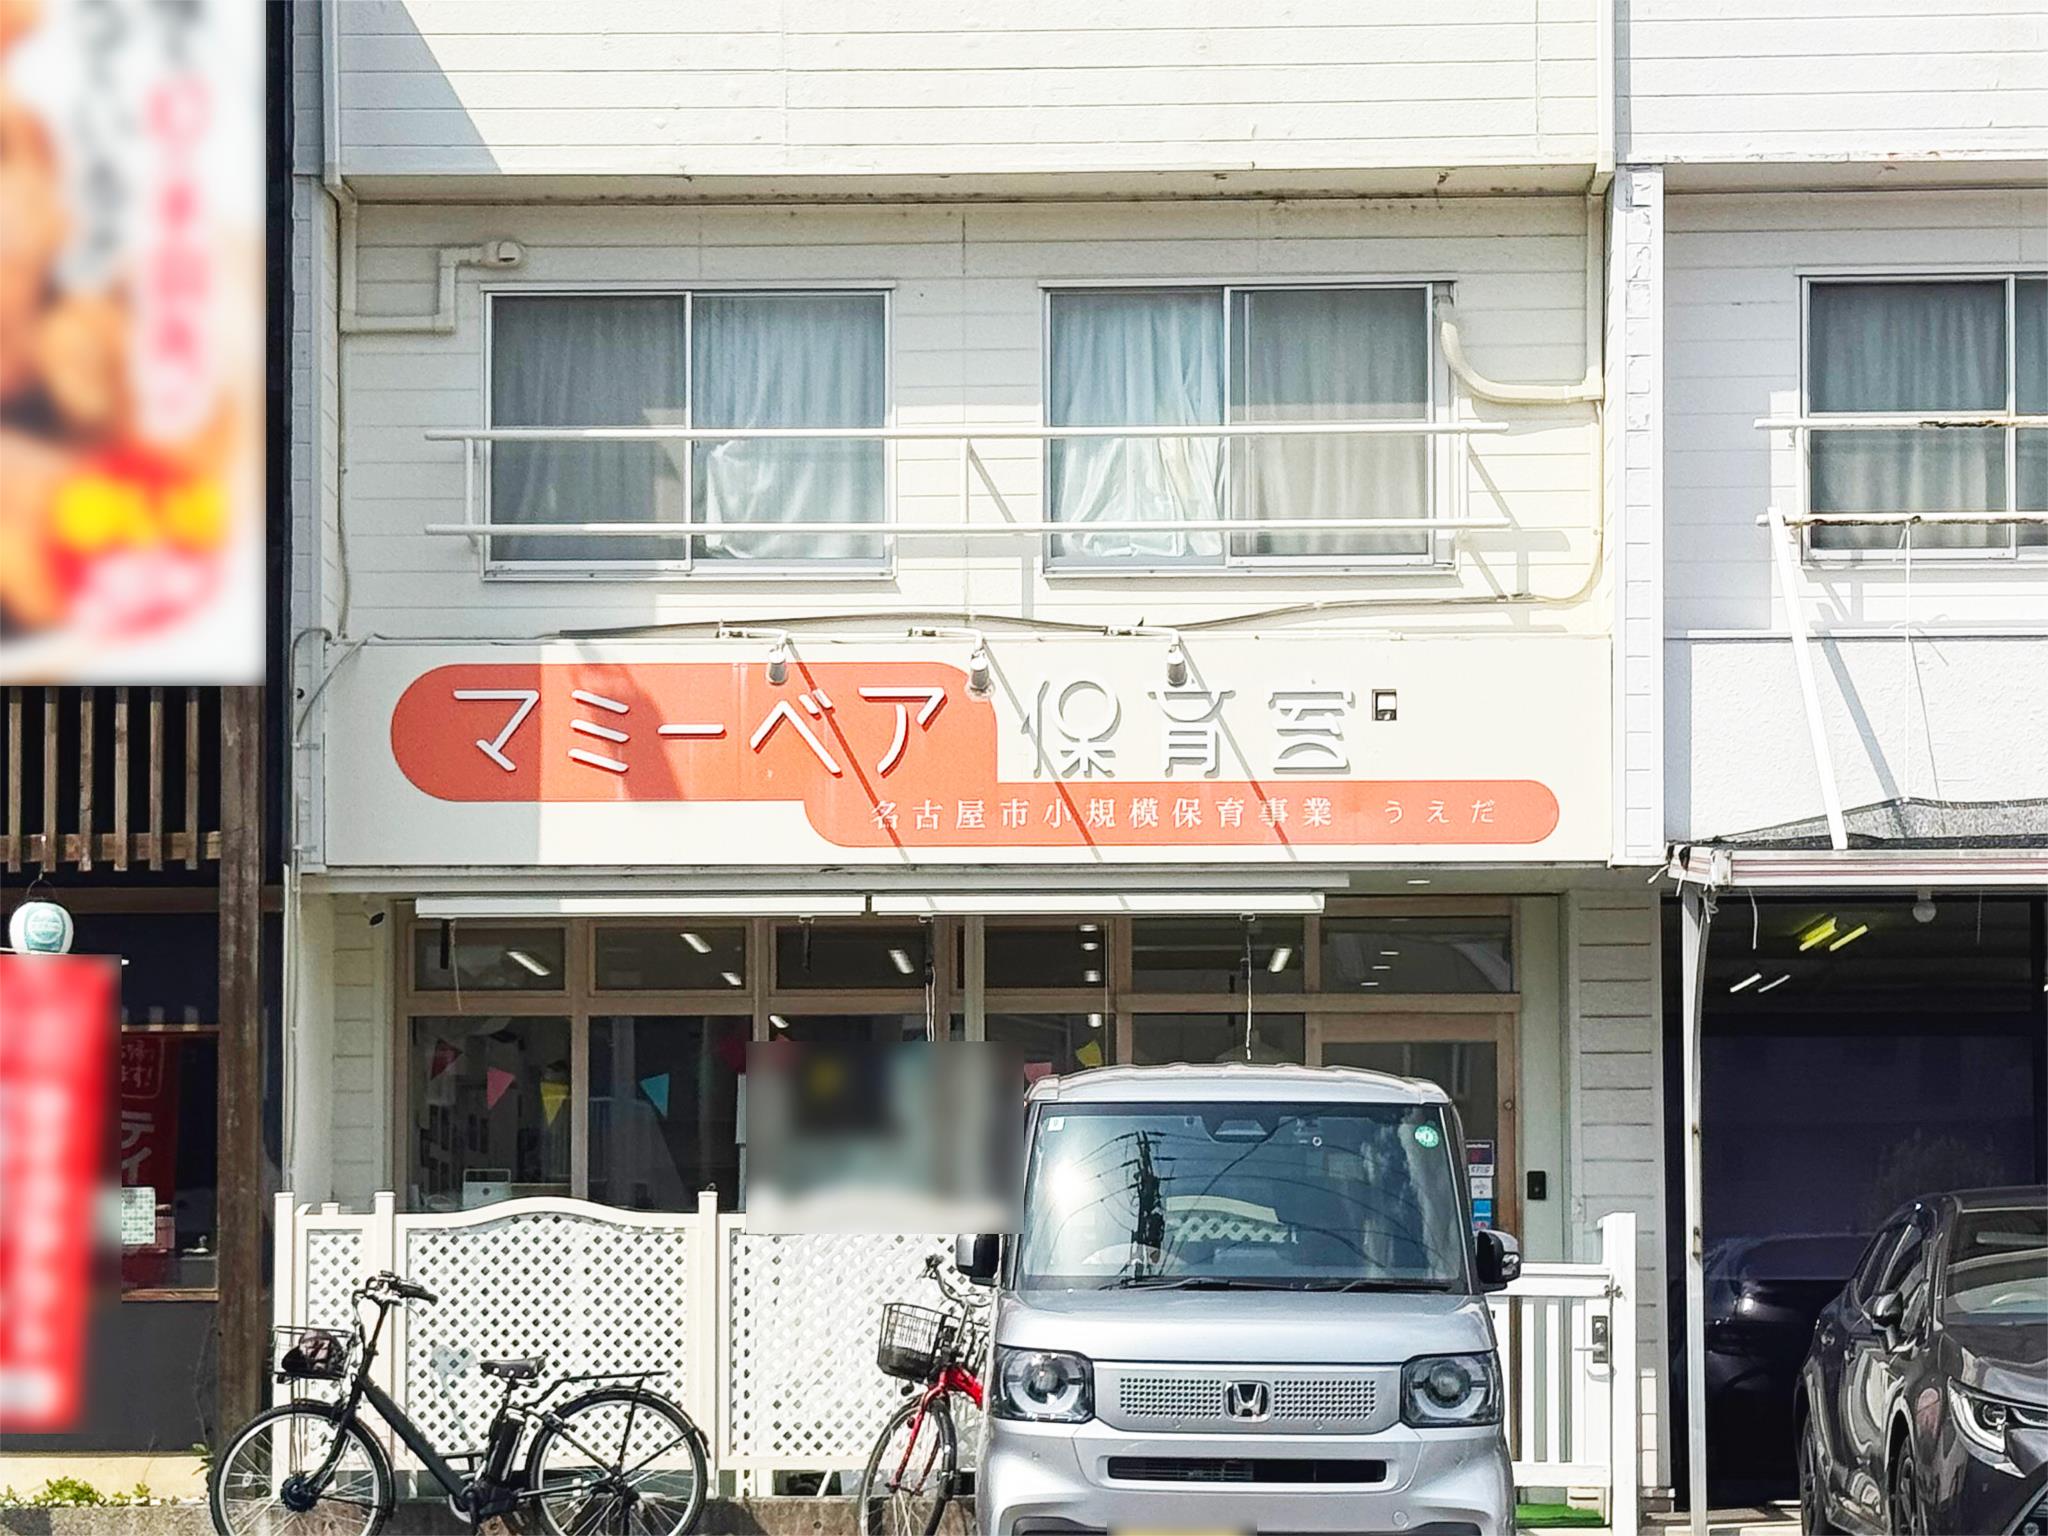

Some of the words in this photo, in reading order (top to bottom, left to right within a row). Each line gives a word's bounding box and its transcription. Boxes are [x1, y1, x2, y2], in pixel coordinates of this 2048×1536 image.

[453, 687, 946, 775] マミーベア
[1019, 674, 1356, 778] 保育室
[870, 797, 1332, 830] 名古屋市小規模保育事業
[1384, 799, 1496, 824] うえだ
